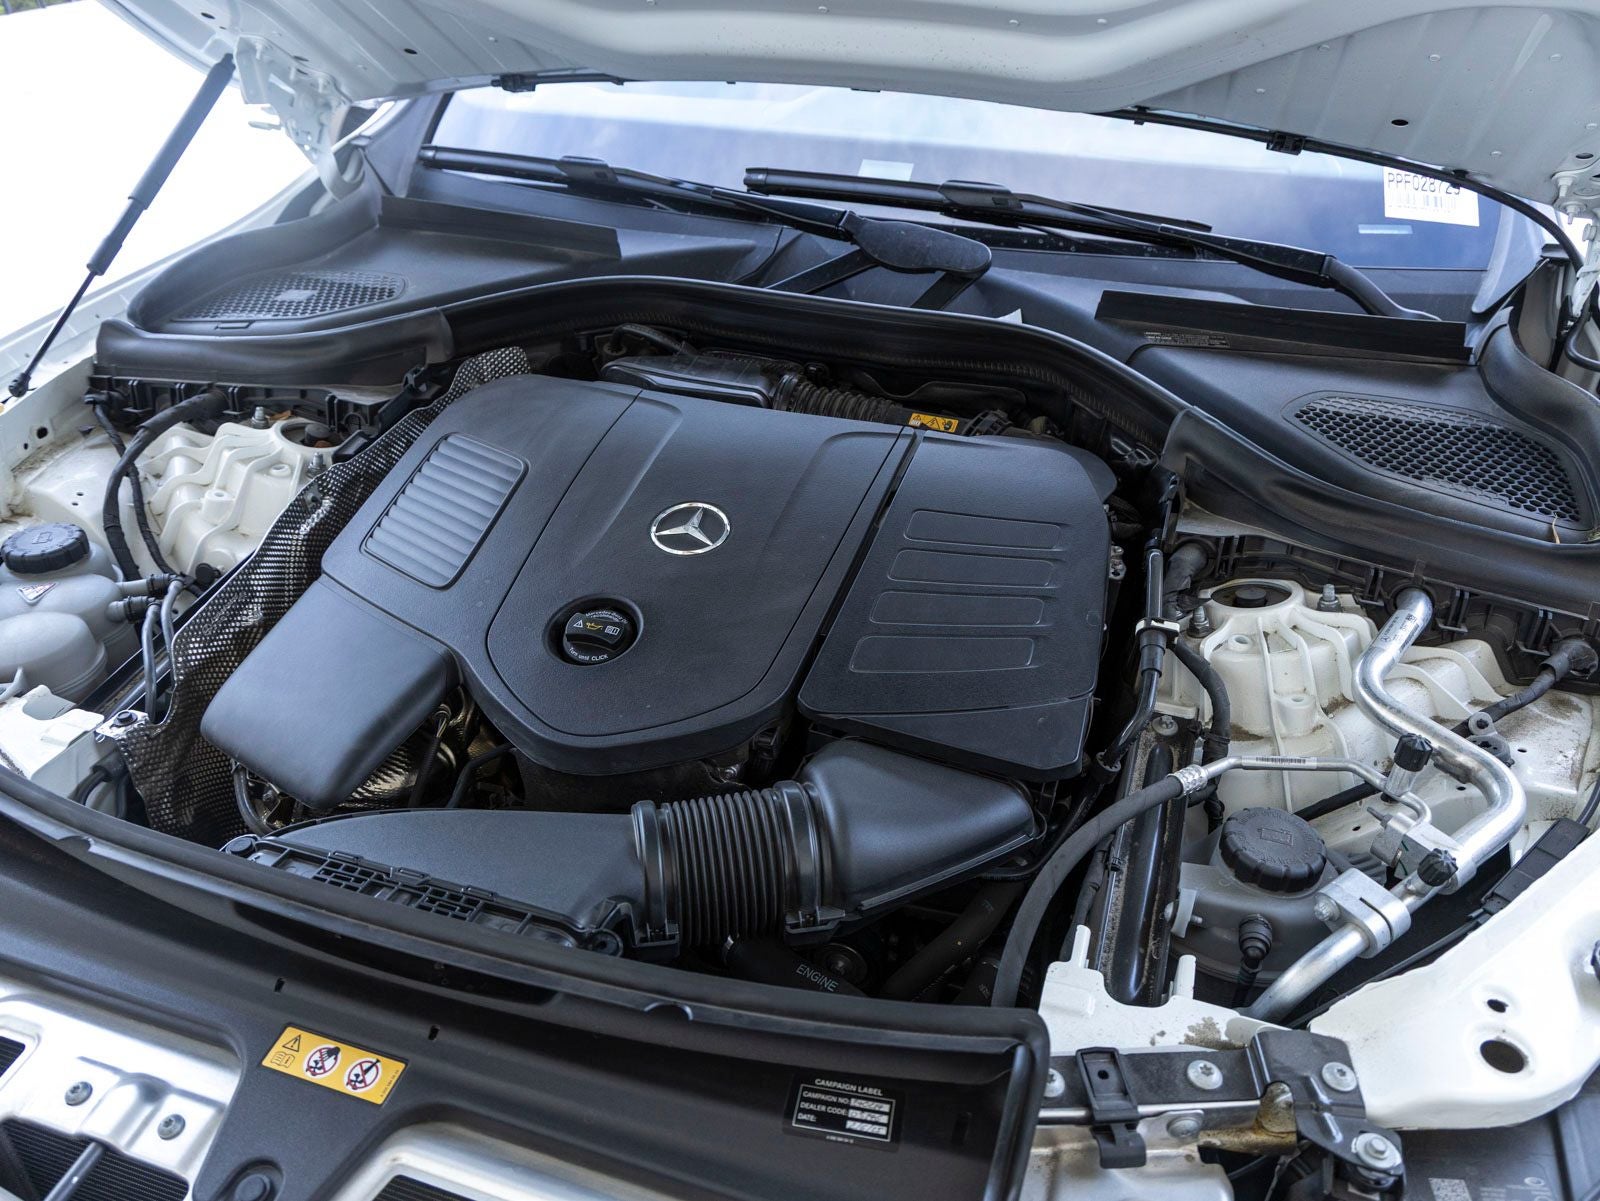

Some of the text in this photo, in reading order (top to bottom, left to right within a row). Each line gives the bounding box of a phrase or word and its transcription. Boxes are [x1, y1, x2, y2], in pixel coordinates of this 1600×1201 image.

[569, 647, 578, 656] Turn
[795, 964, 840, 992] ENGINE
[814, 1078, 883, 1096] CAMPAIGN LABEL
[802, 1090, 838, 1102] CAMPAIGN
[799, 1102, 826, 1112] DEALER
[827, 1106, 848, 1116] CODE:
[797, 1112, 817, 1122] DATE:
